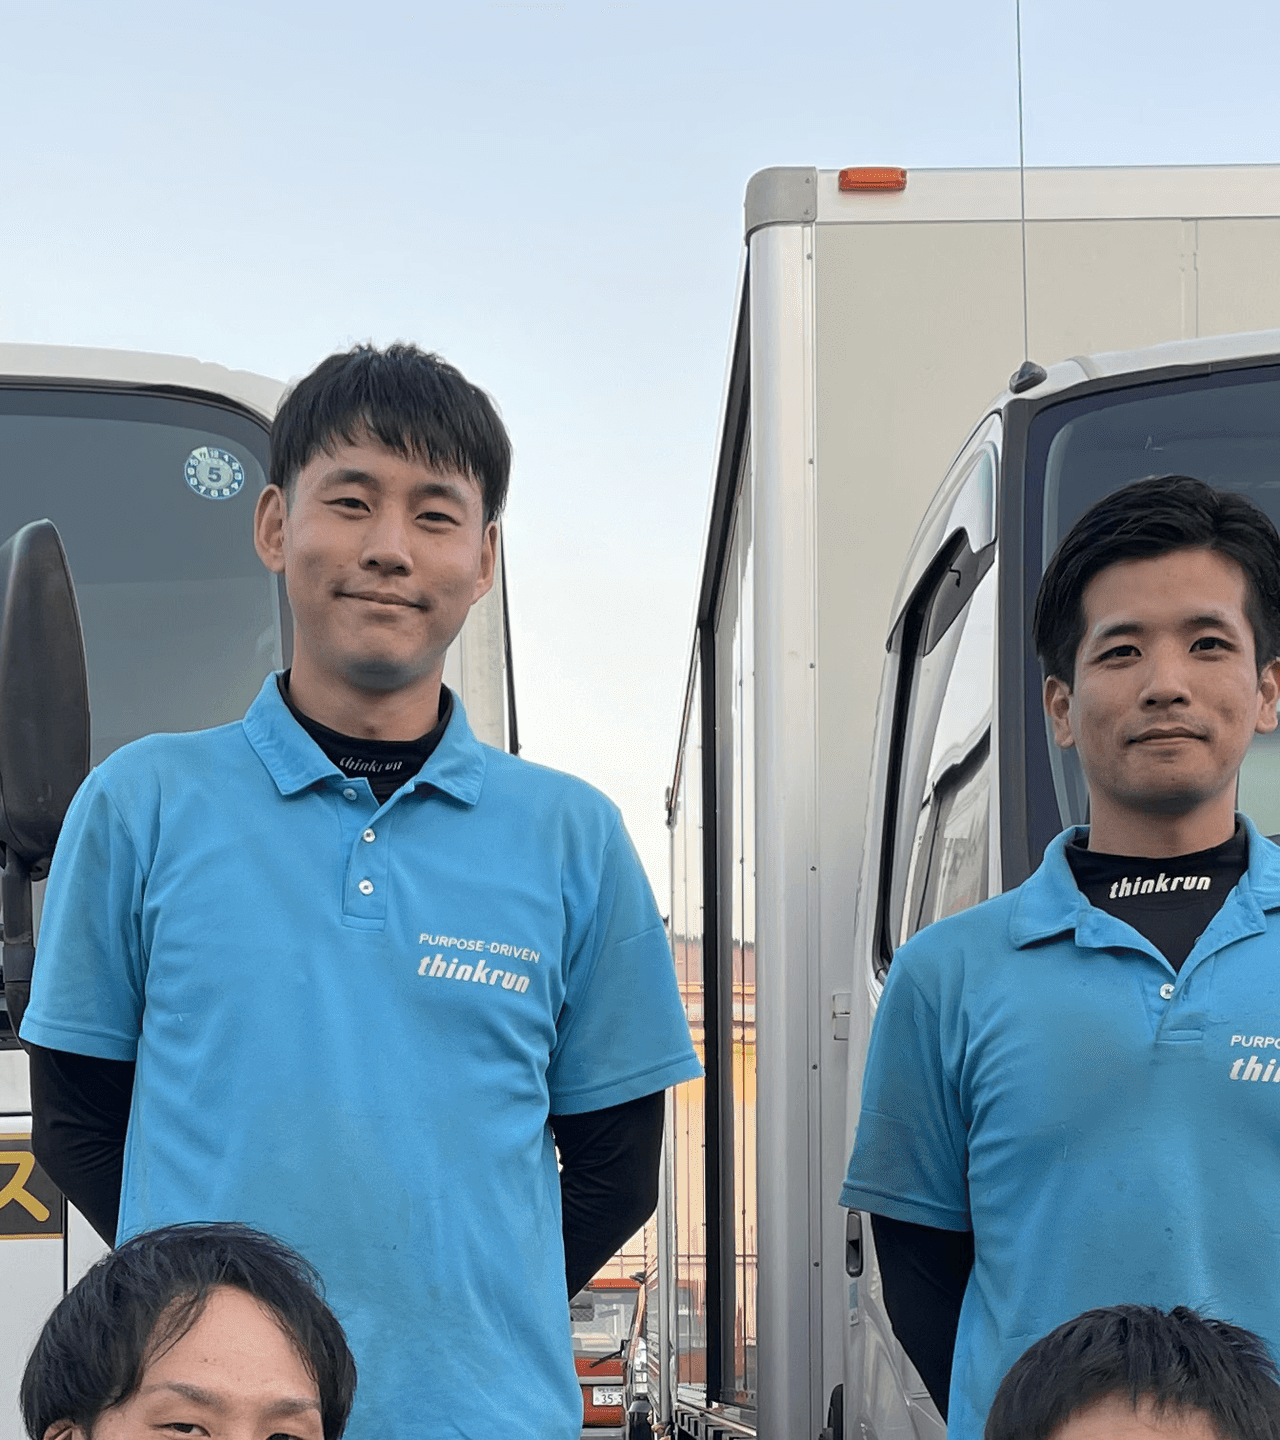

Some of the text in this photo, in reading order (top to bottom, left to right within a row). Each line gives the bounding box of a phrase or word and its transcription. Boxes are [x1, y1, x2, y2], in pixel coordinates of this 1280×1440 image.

[208, 466, 222, 483] 5
[1108, 872, 1212, 899] thinkrun
[418, 932, 541, 964] PURPOSE-DRIVEN
[417, 953, 531, 994] thinkrun
